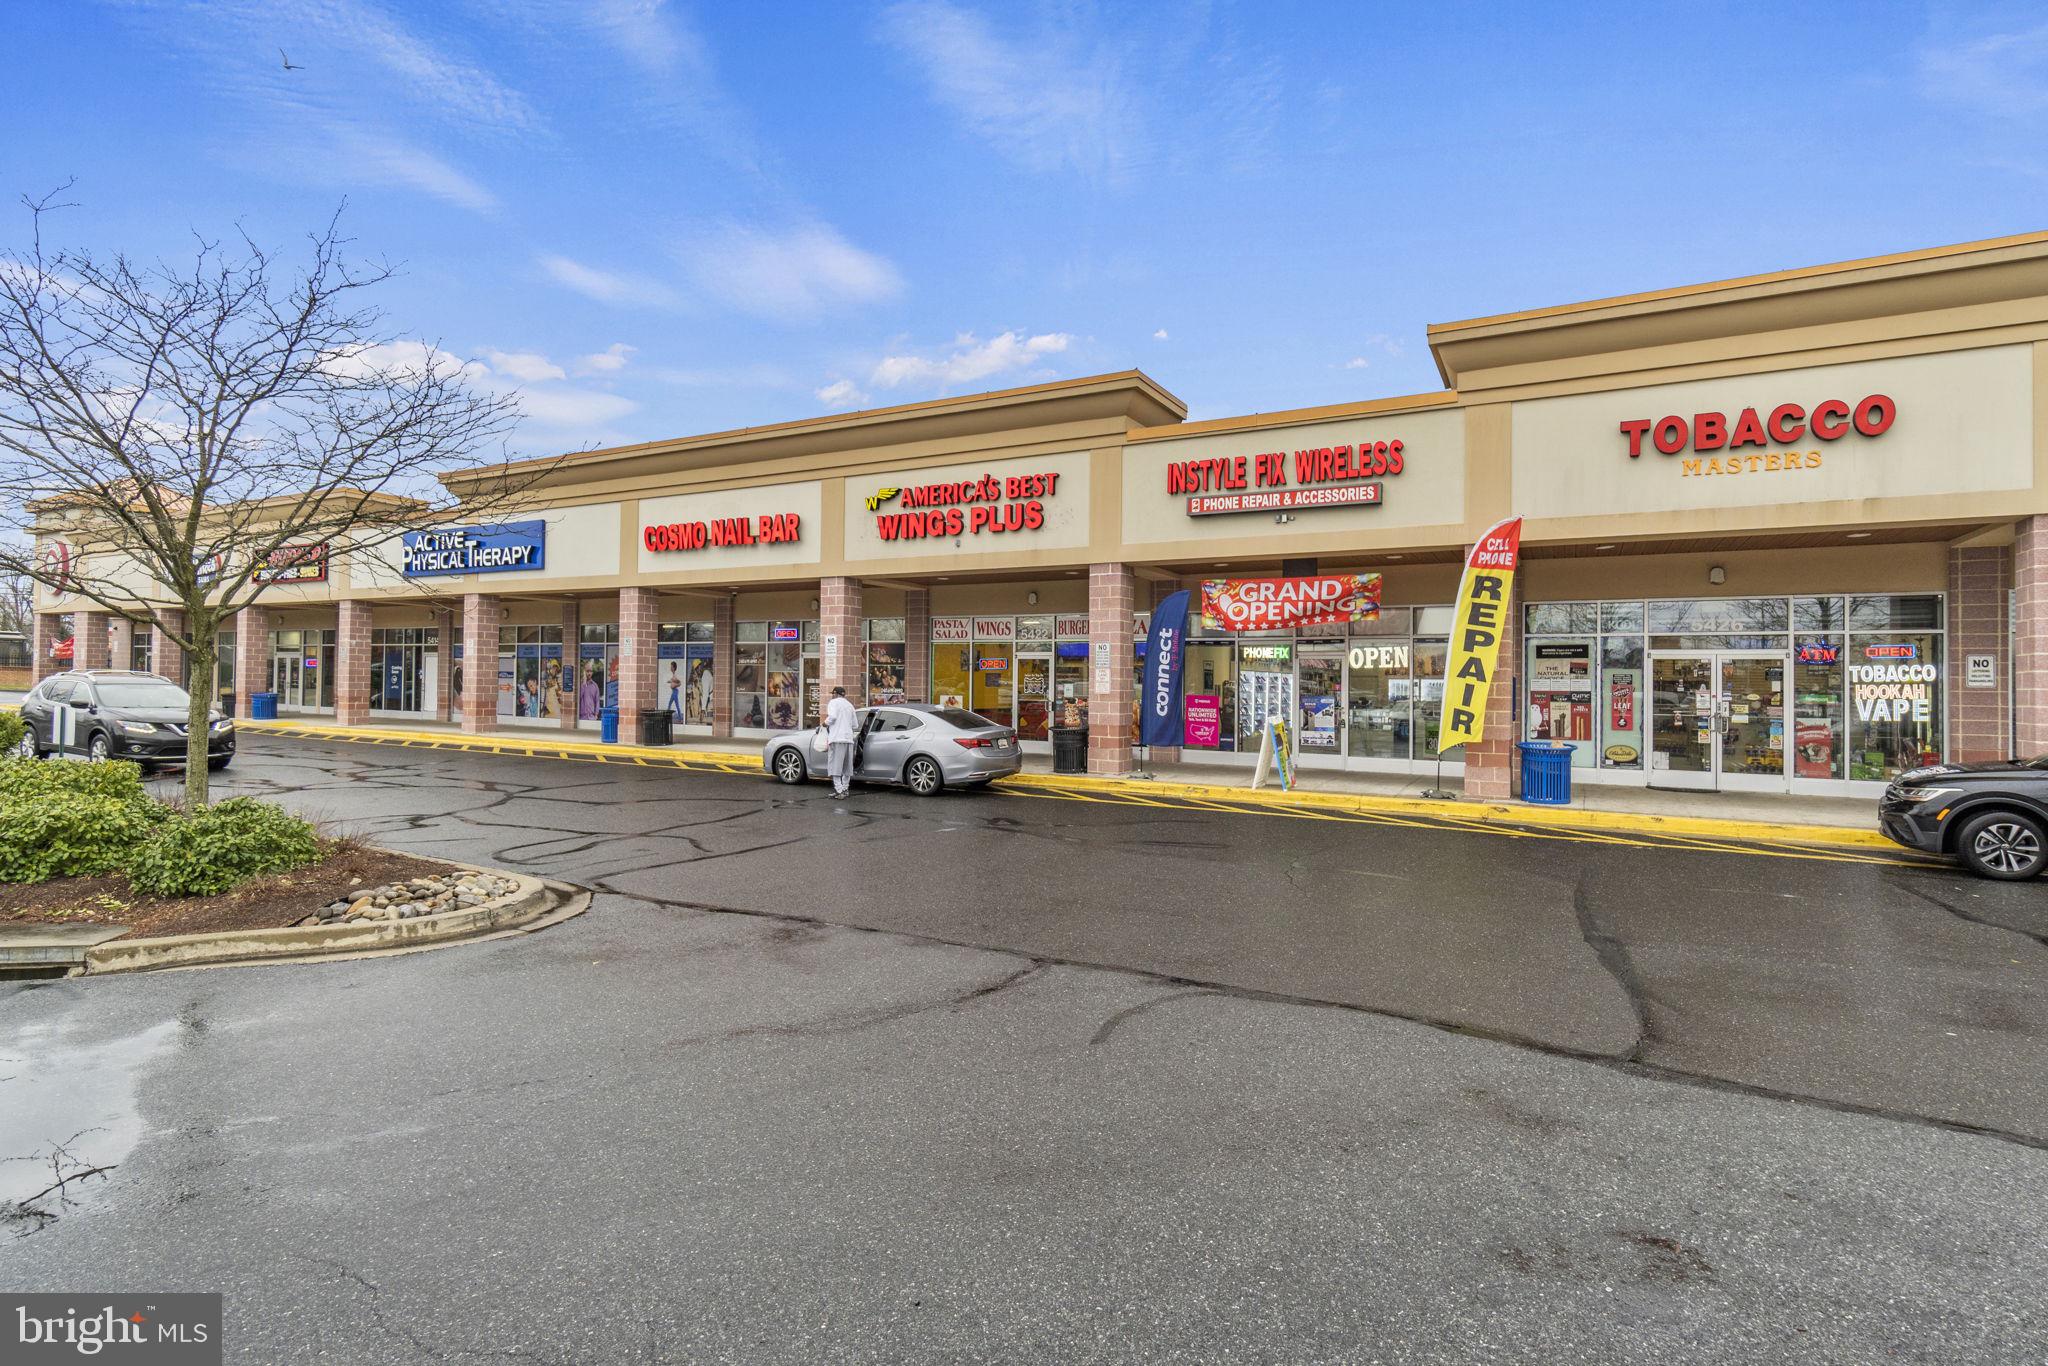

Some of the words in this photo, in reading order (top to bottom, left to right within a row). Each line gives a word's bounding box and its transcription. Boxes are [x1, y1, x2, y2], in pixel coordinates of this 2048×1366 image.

[1620, 394, 1896, 458] TOBACCO
[1167, 456, 1248, 495] INSTYLE
[1255, 452, 1286, 487] FIX
[1295, 439, 1404, 484] WIRELESS
[1682, 451, 1822, 476] MASTERS
[900, 473, 1000, 508] AMERICA'S
[1006, 472, 1059, 500] BEST
[1203, 496, 1239, 511] PHONE
[1242, 492, 1280, 508] REPAIR
[1284, 493, 1291, 505] &
[1295, 486, 1375, 504] ACCESSORIES
[877, 508, 964, 541] WINGS
[970, 500, 1044, 535] PLUS
[414, 531, 464, 551] ACTIVE
[644, 522, 706, 552] COSMO
[711, 517, 755, 547] NAIL
[759, 513, 800, 544] BAR
[1487, 538, 1508, 551] CELL
[402, 546, 464, 571] PHYSICAL
[465, 540, 532, 567] THERAPY
[1478, 552, 1513, 566] PHONE
[1239, 580, 1342, 602] GRAND
[1227, 597, 1356, 622] OPENING
[776, 630, 797, 638] OPEN
[934, 618, 971, 629] PASTA/
[935, 629, 968, 639] SALAD
[976, 621, 1011, 636] WINGS
[1021, 629, 1048, 639] 5422
[1692, 620, 1743, 631] 5426
[1350, 646, 1409, 669] OPEN
[1450, 575, 1503, 735] REPAIR
[1800, 649, 1836, 661] ATM
[1866, 647, 1913, 657] OPEN
[980, 660, 1006, 668] OPEN
[1156, 628, 1173, 717] connect
[1849, 665, 1936, 682] TOBACCO
[1855, 684, 1925, 700] HOOKAH
[1855, 699, 1930, 721] VAPE
